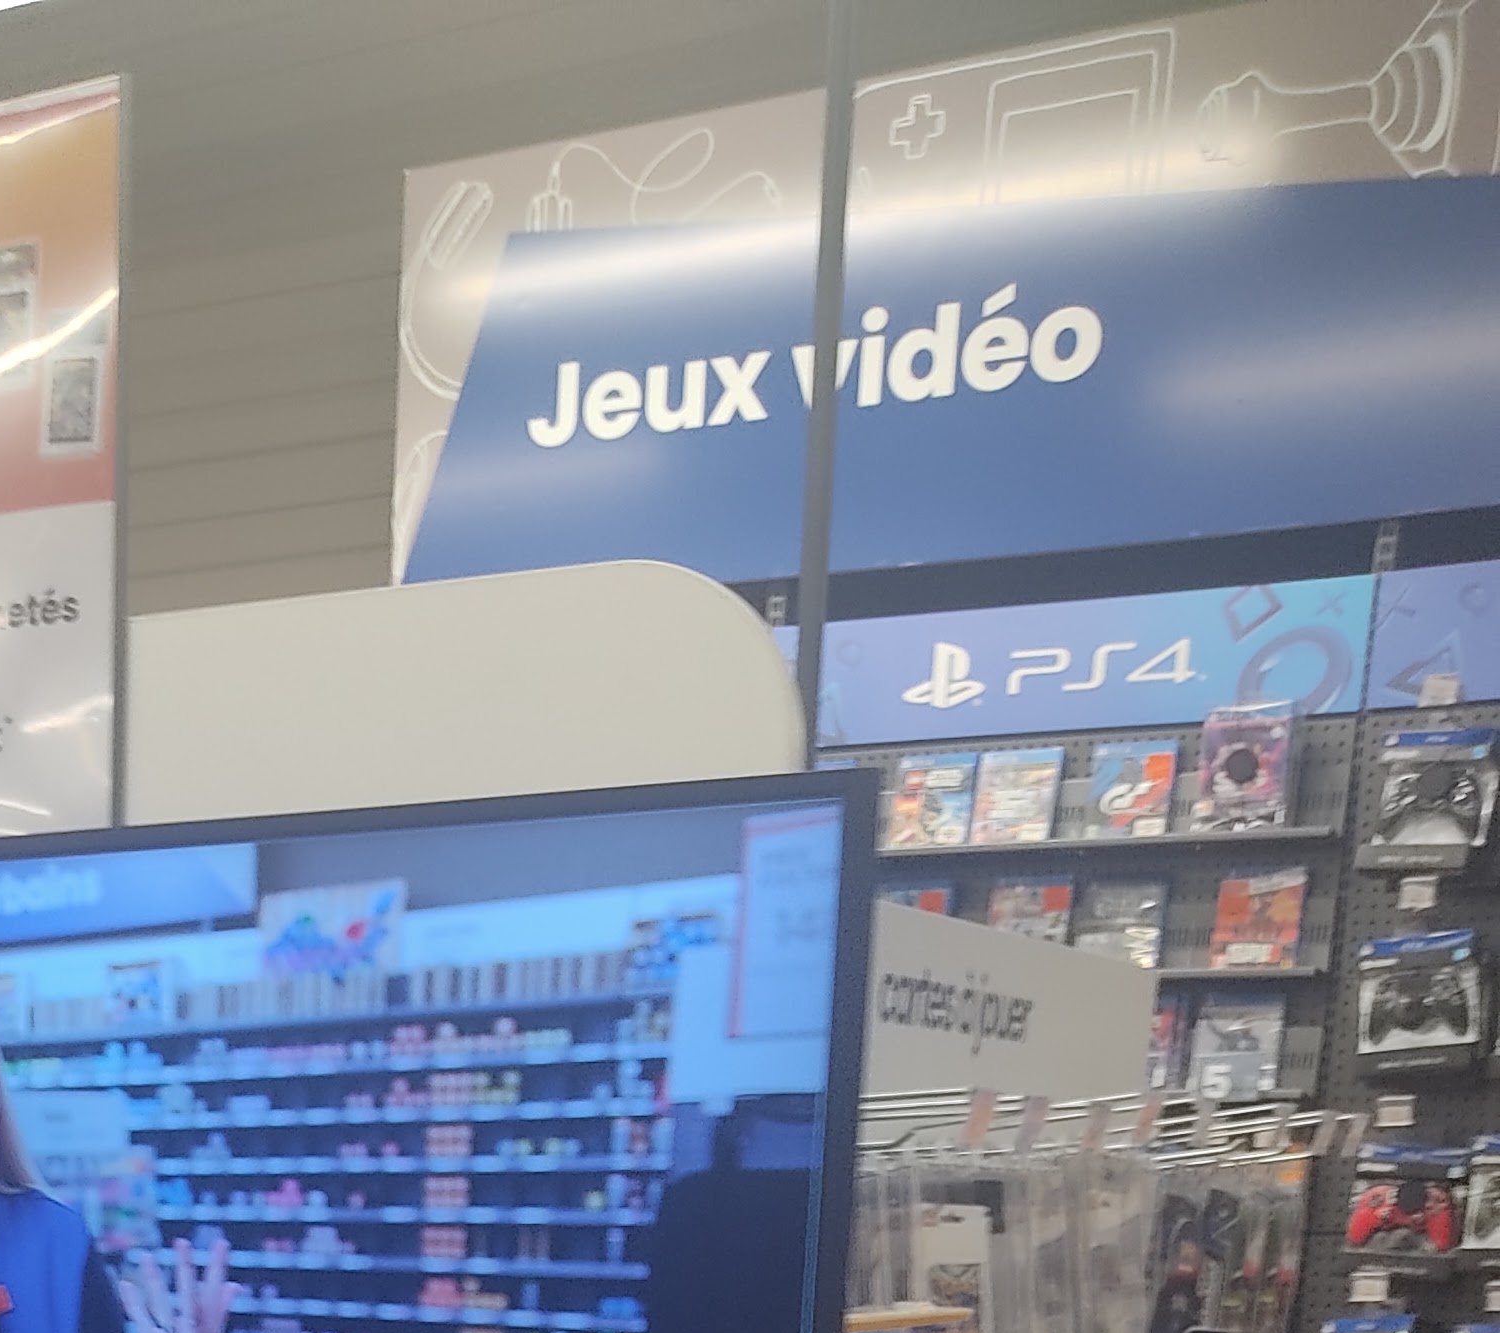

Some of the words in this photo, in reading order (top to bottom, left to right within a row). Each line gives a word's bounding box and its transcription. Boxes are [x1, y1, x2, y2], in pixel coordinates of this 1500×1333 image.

[526, 350, 772, 449] Jeux
[791, 282, 1103, 412] vidéo
[1005, 638, 1197, 697] PS4
